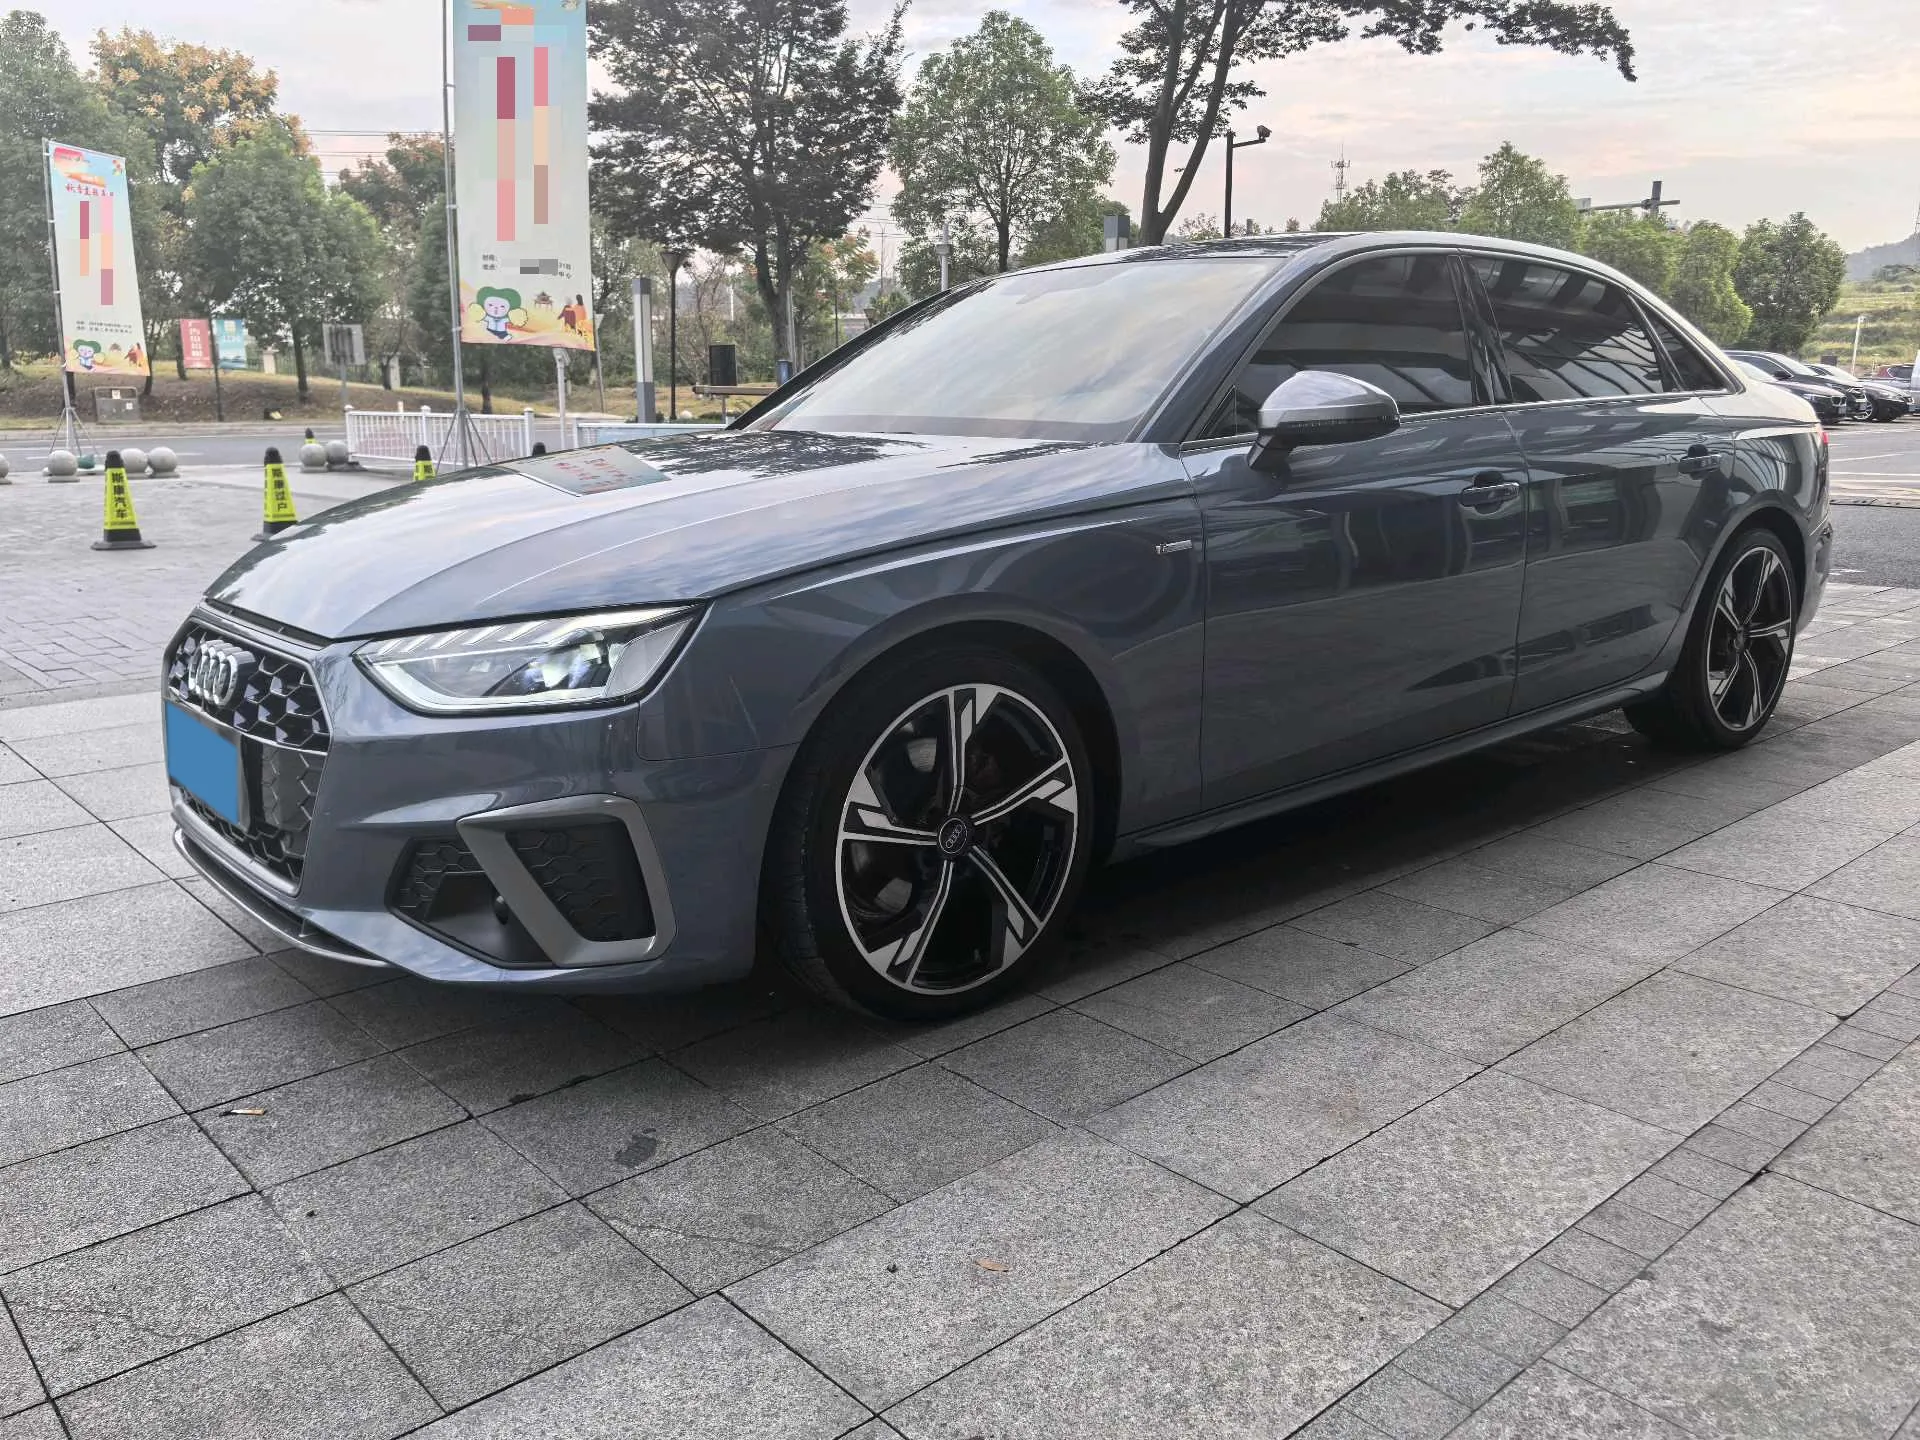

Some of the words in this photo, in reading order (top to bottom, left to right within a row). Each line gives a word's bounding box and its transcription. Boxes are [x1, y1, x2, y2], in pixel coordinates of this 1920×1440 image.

[112, 472, 127, 518] 斯康汽车
[272, 468, 287, 512] 斯康过户
